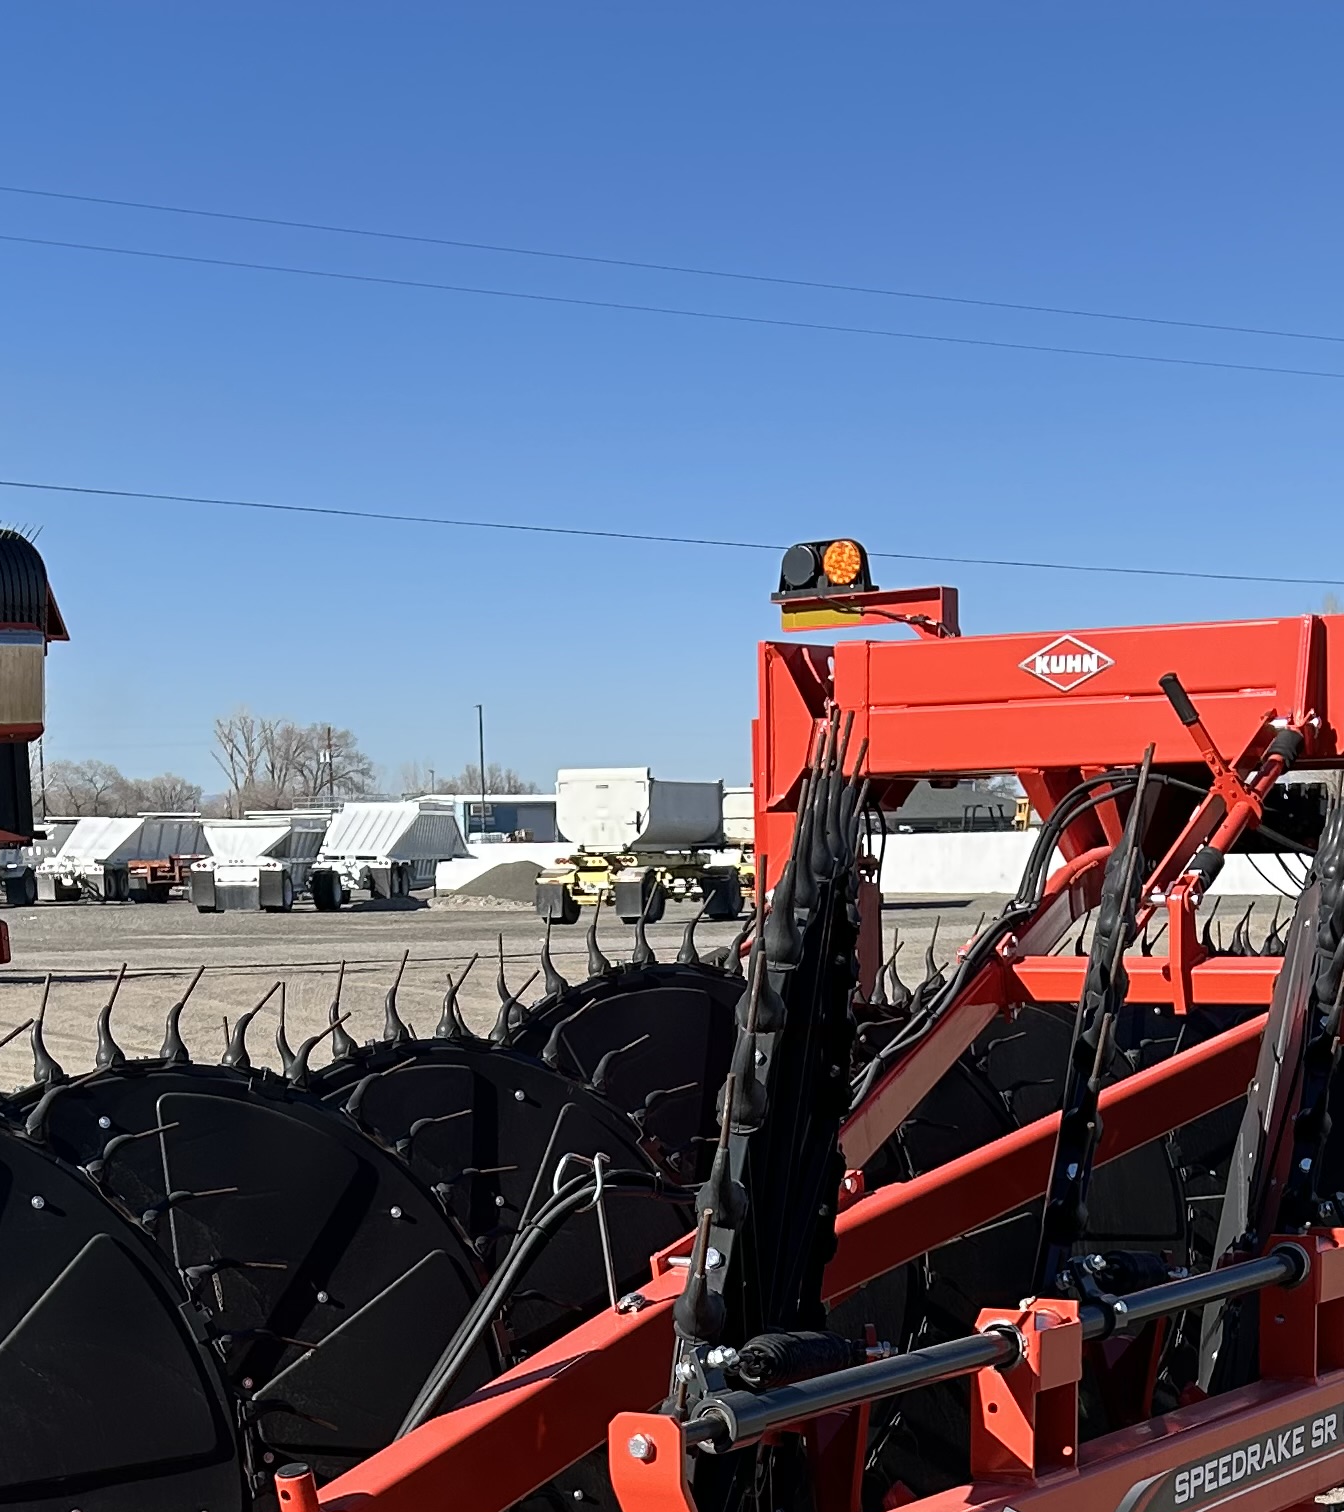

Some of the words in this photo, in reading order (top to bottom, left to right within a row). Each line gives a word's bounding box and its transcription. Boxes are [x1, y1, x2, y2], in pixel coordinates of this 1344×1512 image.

[1036, 653, 1098, 674] KUHN
[1174, 1426, 1305, 1504] SPEEDRAKE
[1311, 1413, 1337, 1448] SR
